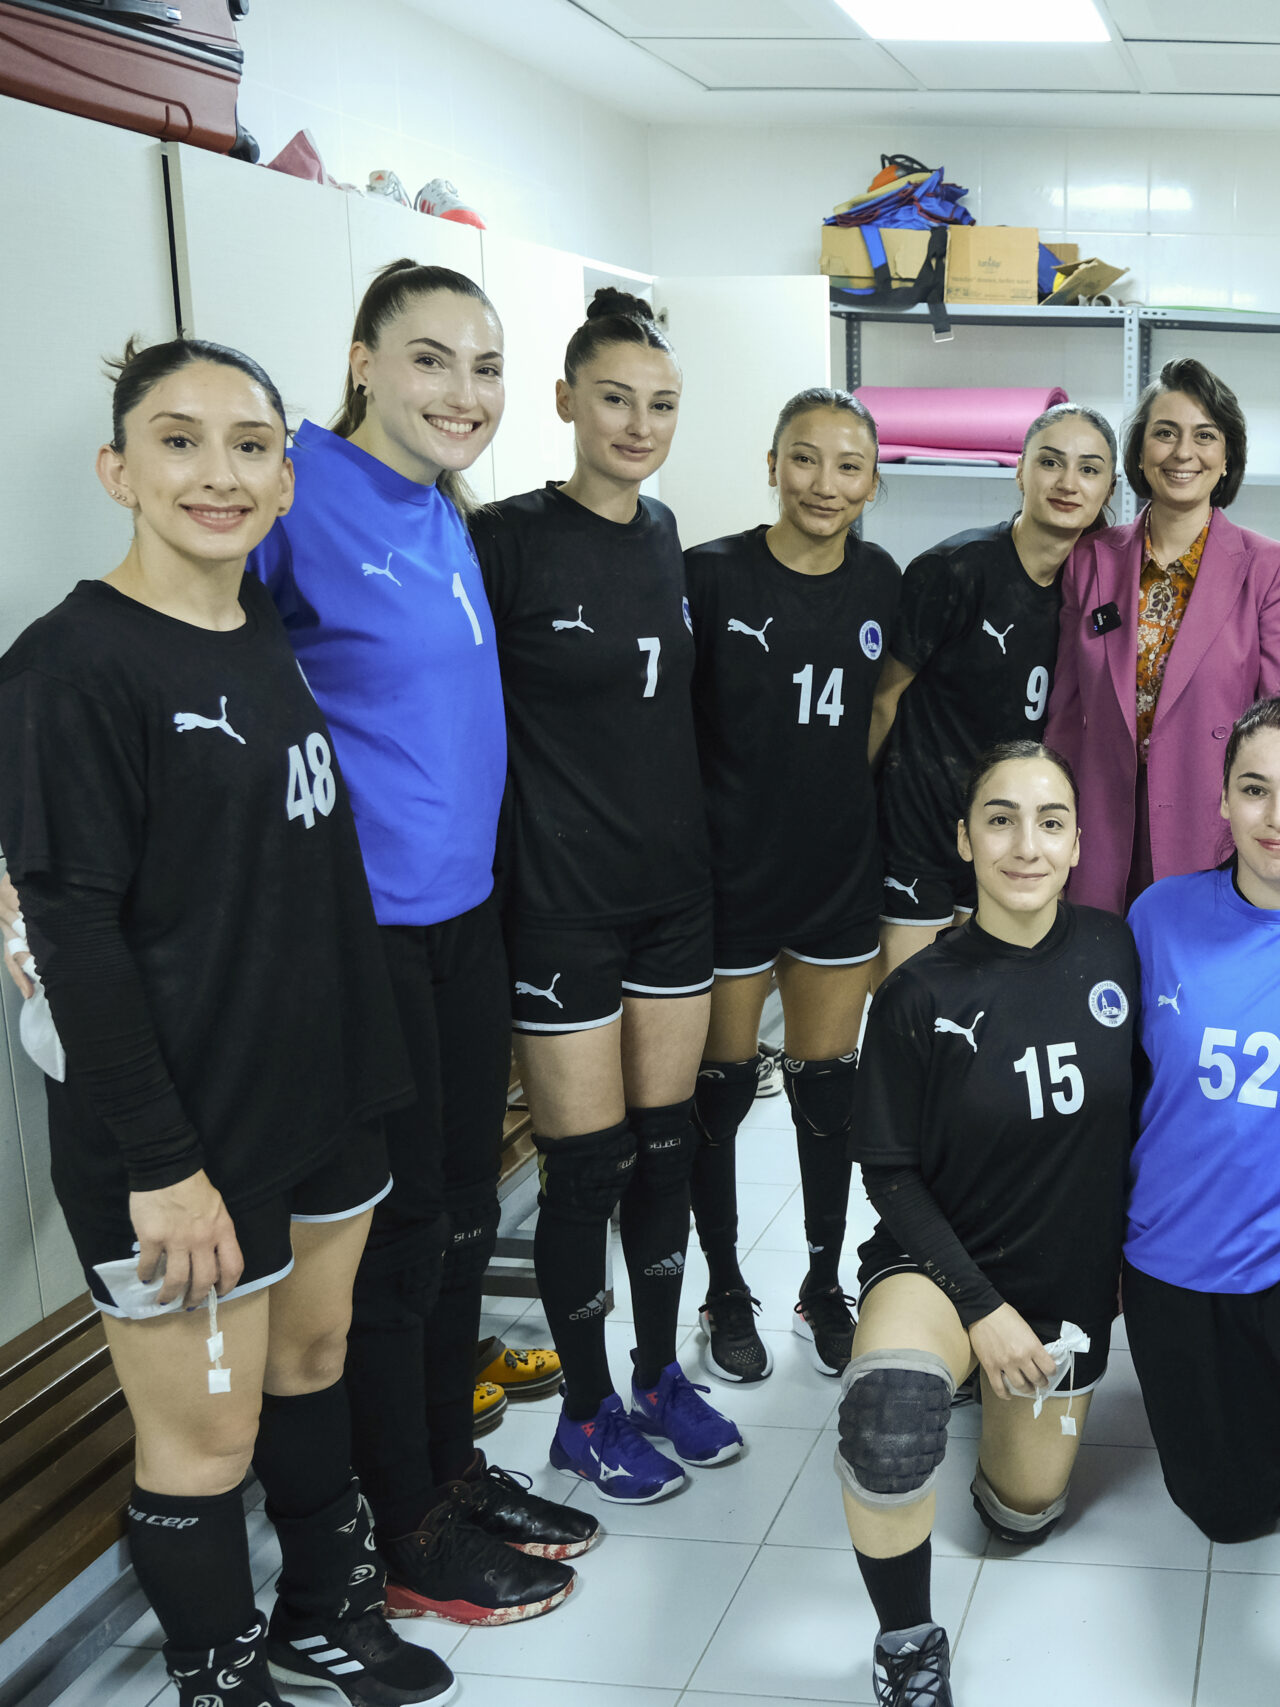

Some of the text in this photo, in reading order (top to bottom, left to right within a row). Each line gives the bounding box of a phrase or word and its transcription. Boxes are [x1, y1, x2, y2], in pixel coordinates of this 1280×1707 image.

[452, 573, 483, 645] 1
[637, 637, 660, 697] 7
[792, 664, 845, 727] 14
[1025, 666, 1048, 721] 9
[287, 733, 335, 829] 48
[1014, 1042, 1084, 1119] 15
